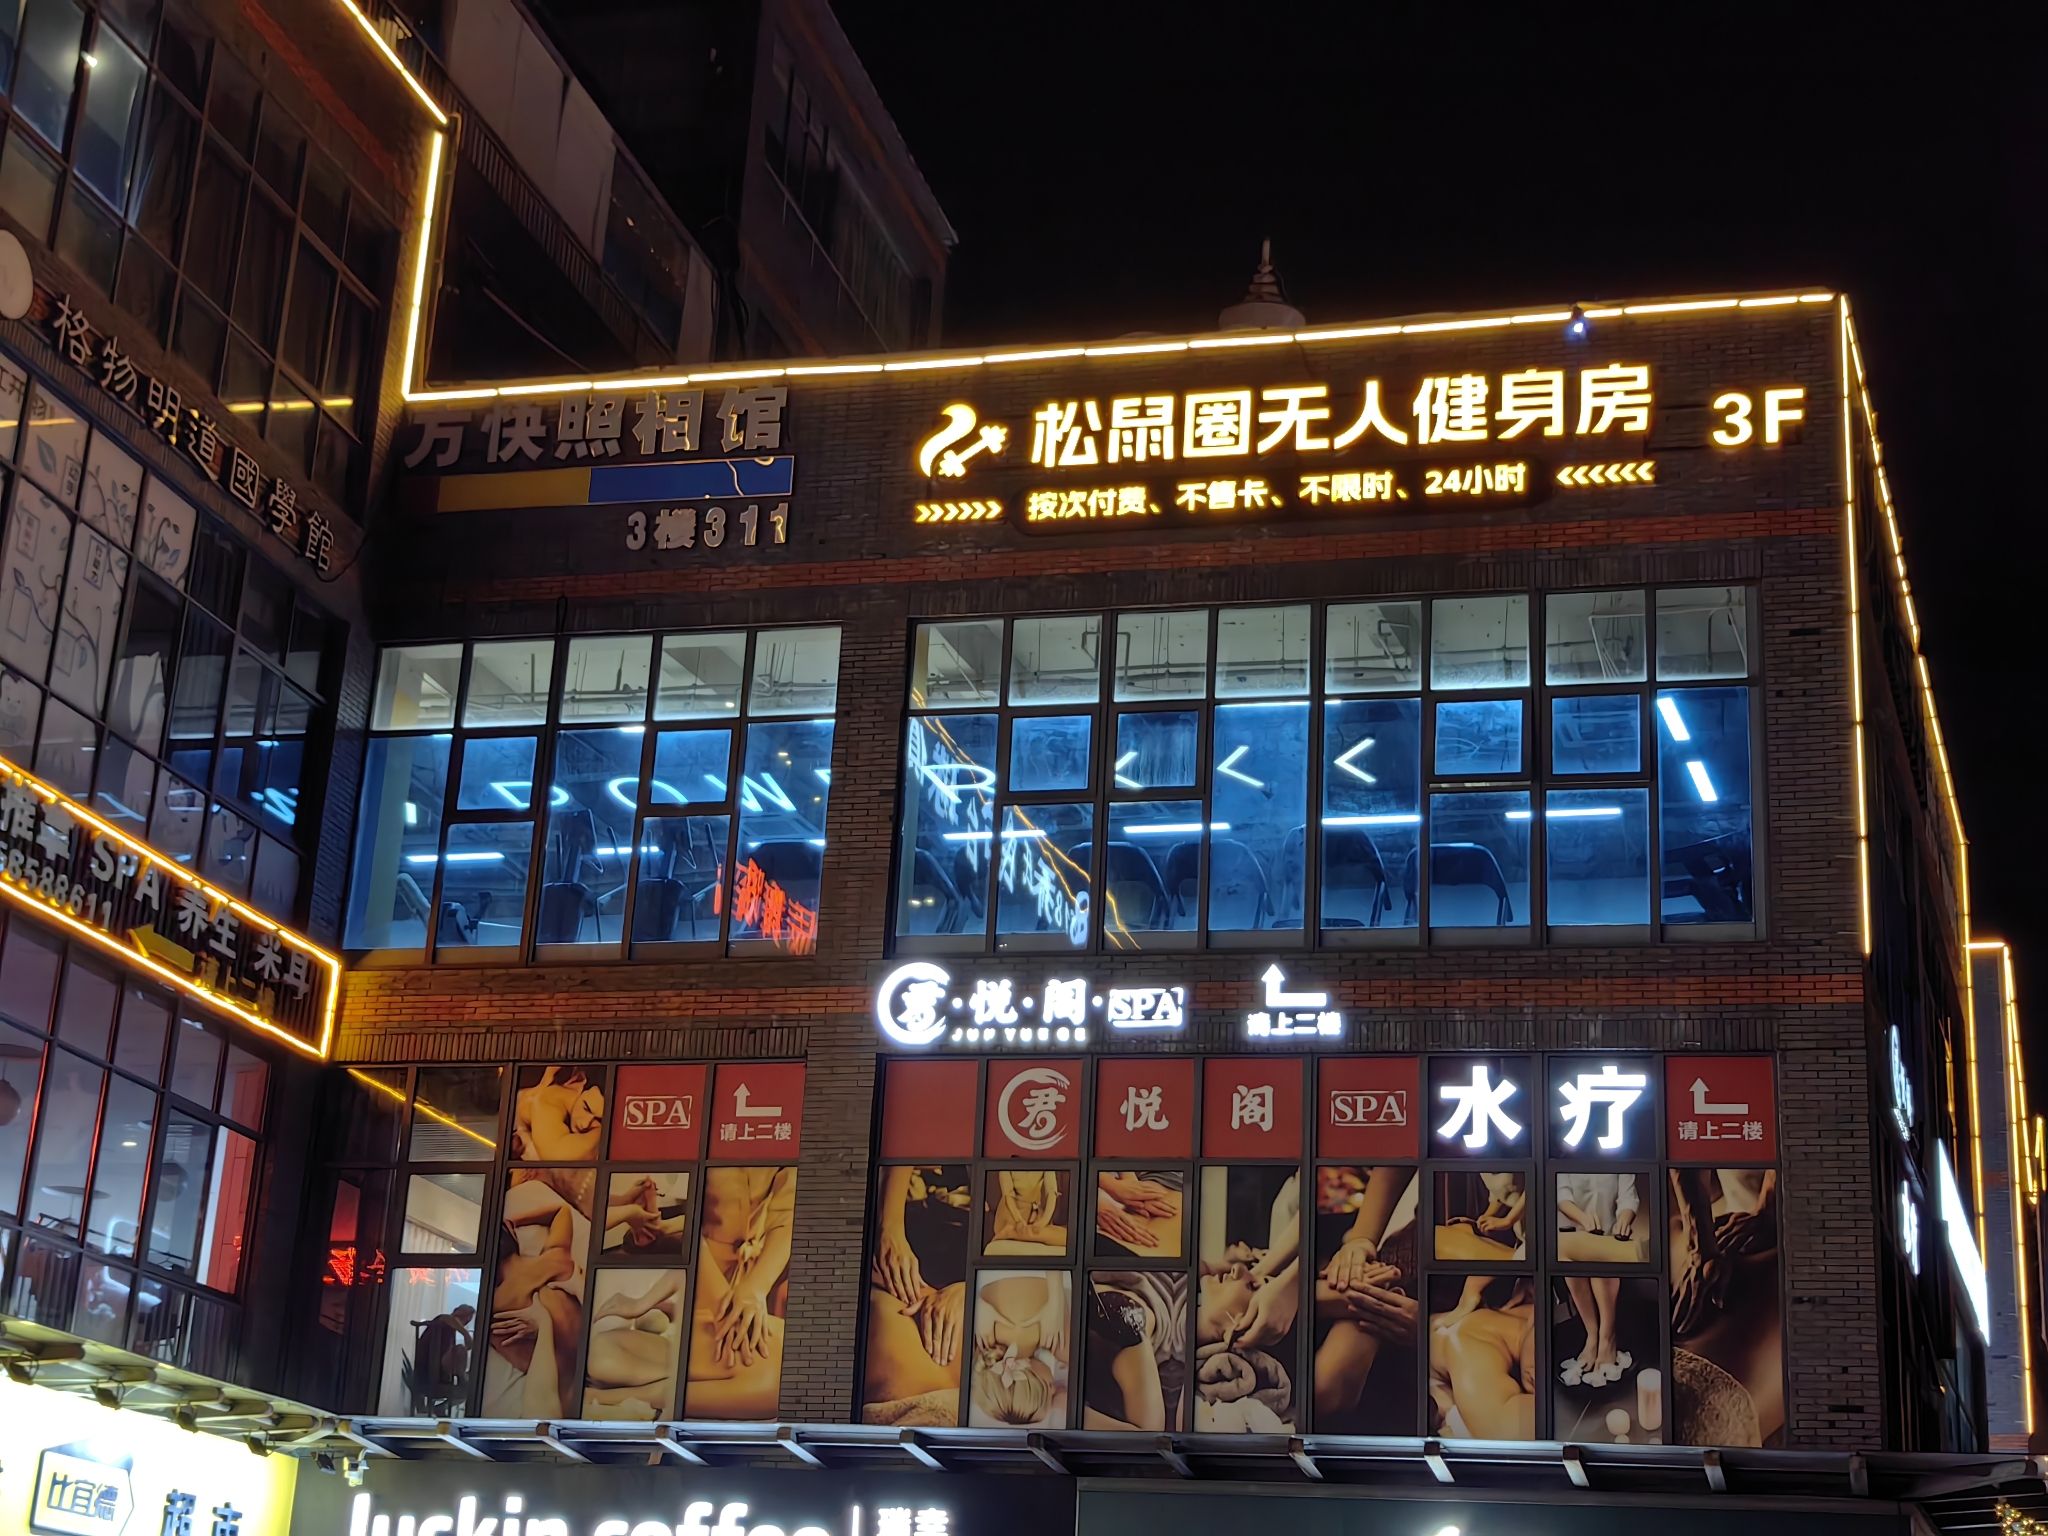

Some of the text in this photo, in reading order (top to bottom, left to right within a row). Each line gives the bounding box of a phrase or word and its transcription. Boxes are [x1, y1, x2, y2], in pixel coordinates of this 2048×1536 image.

[52, 293, 334, 571] 格物明道國學館
[1031, 363, 1805, 468] 松鼠圈无人健身房 3F
[91, 834, 160, 911] SPA
[626, 1099, 689, 1126] SPA
[720, 1122, 792, 1141] 请上二楼
[1333, 1094, 1405, 1123] SPA
[1438, 1065, 1648, 1150] 水疗
[1677, 1120, 1764, 1142] 请上二楼
